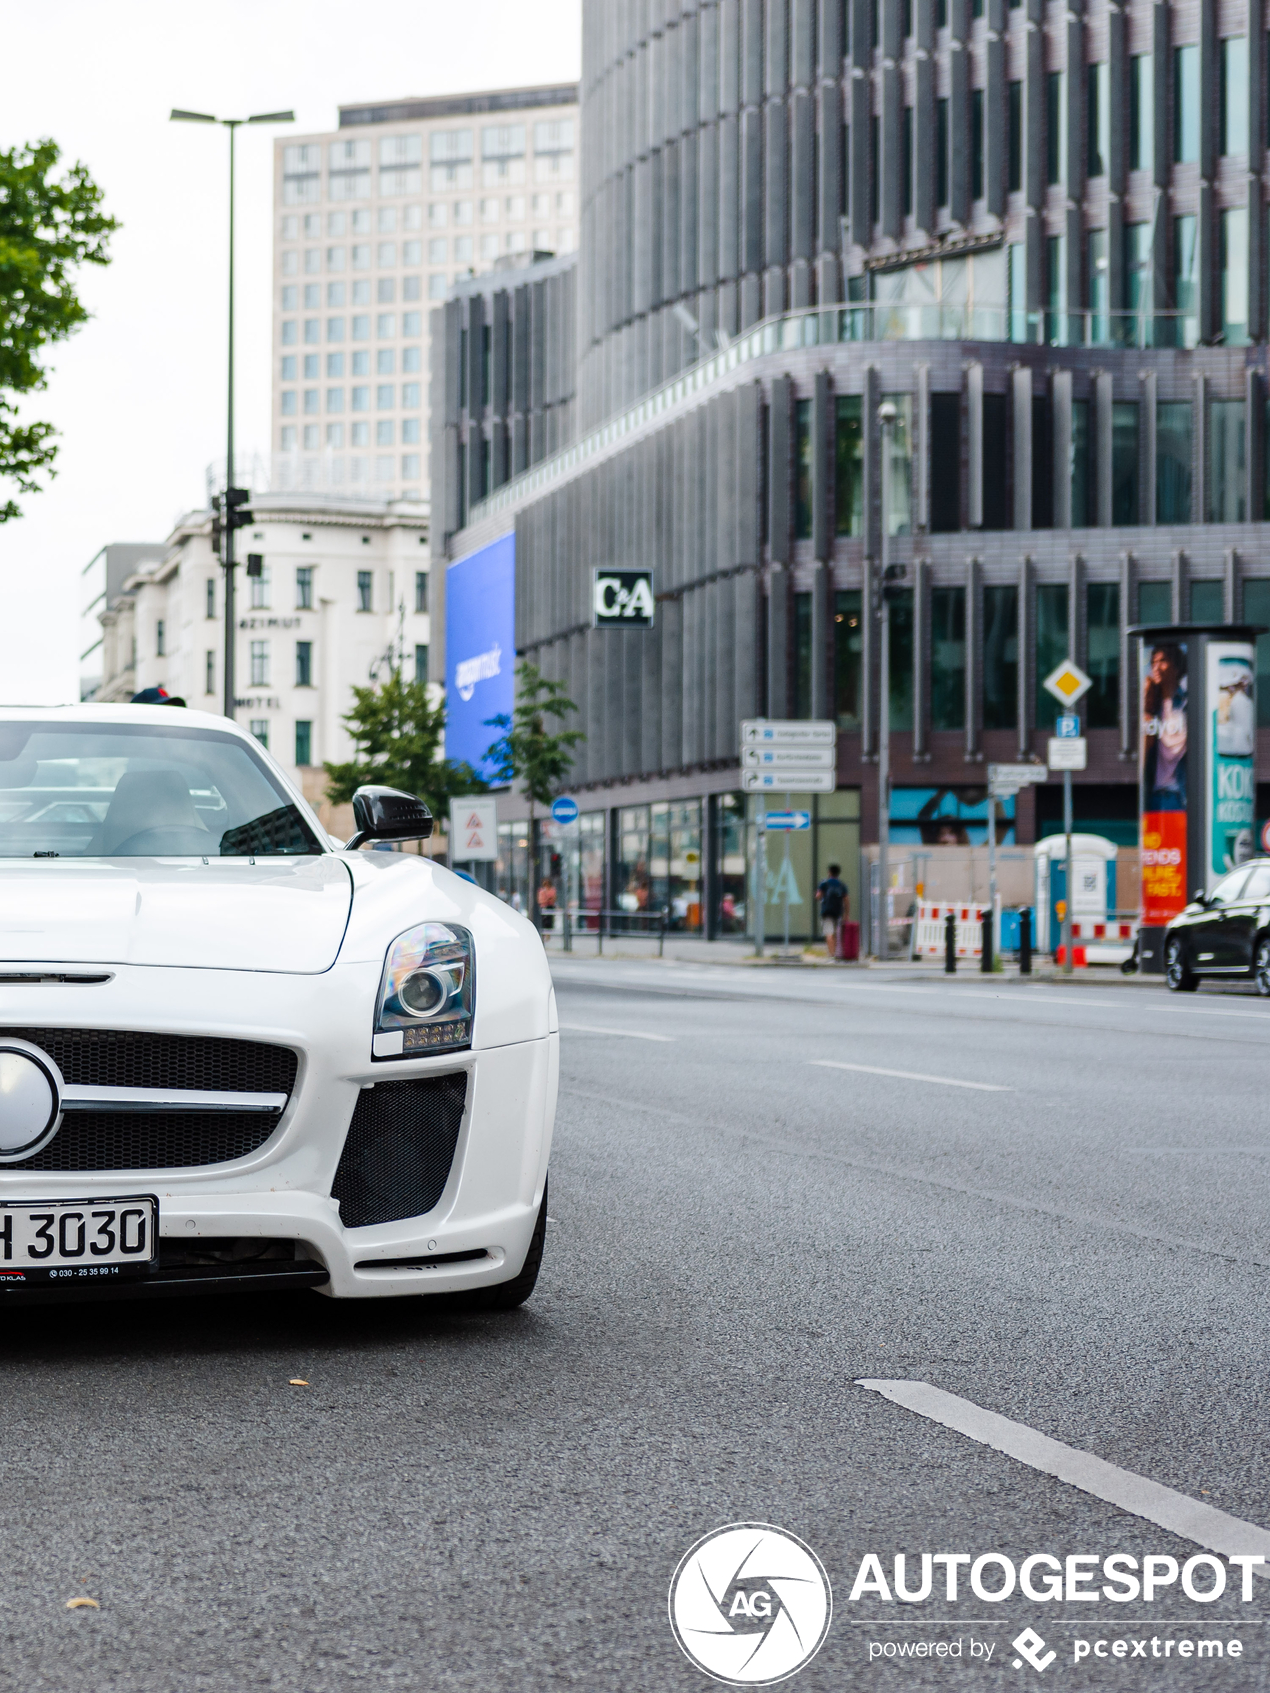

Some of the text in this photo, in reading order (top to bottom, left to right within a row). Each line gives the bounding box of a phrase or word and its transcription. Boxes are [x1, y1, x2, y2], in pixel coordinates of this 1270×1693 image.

[595, 577, 655, 618] C&A
[28, 1208, 147, 1259] 3030
[59, 1269, 73, 1277] 030
[78, 1269, 88, 1277] 25
[89, 1268, 98, 1276] 35
[99, 1268, 109, 1276] 99
[110, 1267, 119, 1275] 14
